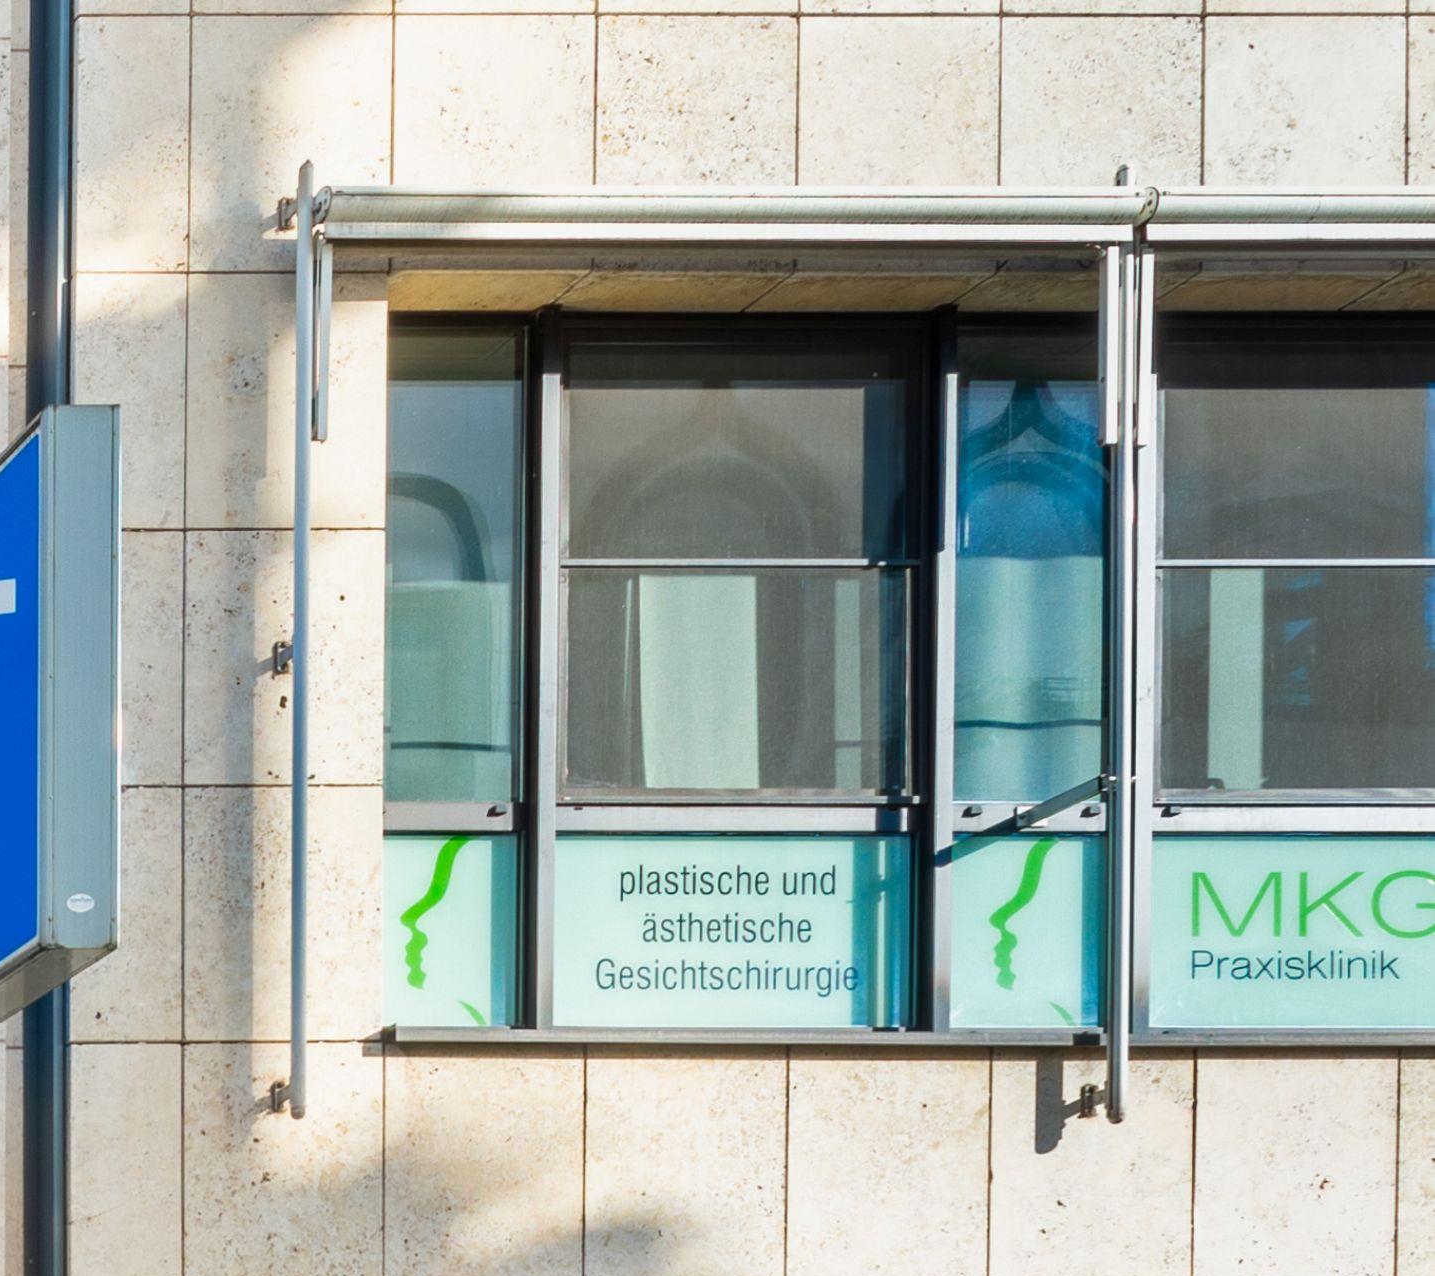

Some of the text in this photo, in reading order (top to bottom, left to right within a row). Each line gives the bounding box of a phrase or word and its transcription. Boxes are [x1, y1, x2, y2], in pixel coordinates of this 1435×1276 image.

[619, 864, 837, 902] plastische und
[1191, 870, 1435, 939] MKG
[642, 912, 813, 943] ästhetische
[595, 958, 859, 998] Gesichtschirurgie
[1190, 949, 1400, 981] Praxisklinik
